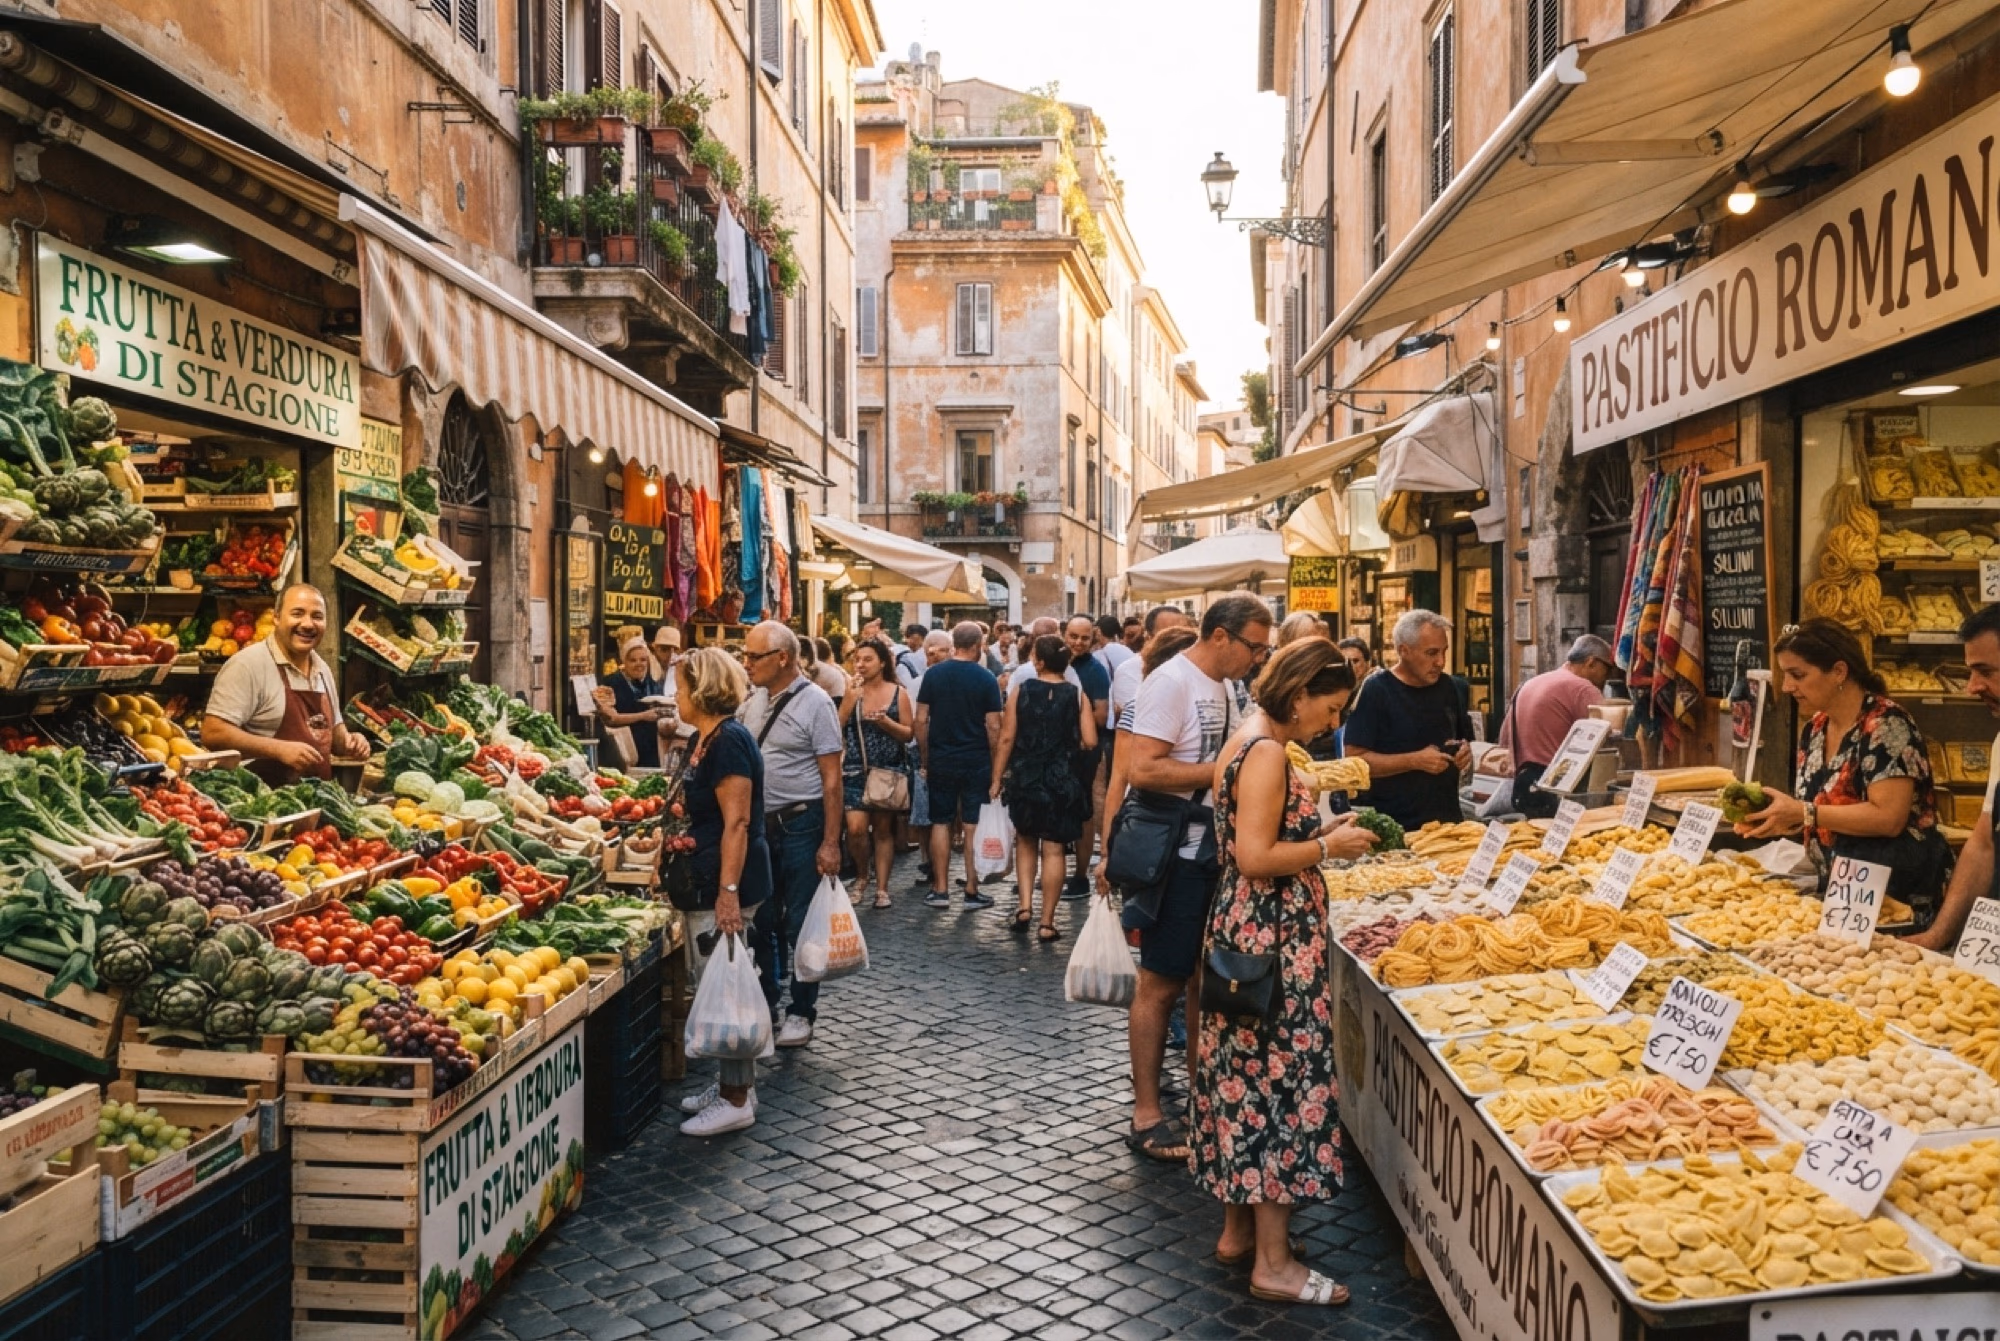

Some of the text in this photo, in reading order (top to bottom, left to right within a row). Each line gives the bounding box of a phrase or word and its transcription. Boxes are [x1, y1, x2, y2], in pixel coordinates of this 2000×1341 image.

[59, 253, 354, 403] FRUTTA & VERDURA
[1581, 135, 2000, 434] PASTIFICIO ROMAN
[116, 341, 340, 437] DI STAGIONE
[424, 1107, 495, 1215] FRUTTA
[500, 1092, 510, 1148] &
[515, 1035, 581, 1132] VERDURA
[458, 1114, 560, 1259] DI STAGIONE
[1373, 1009, 1465, 1223] PASTIFICIO
